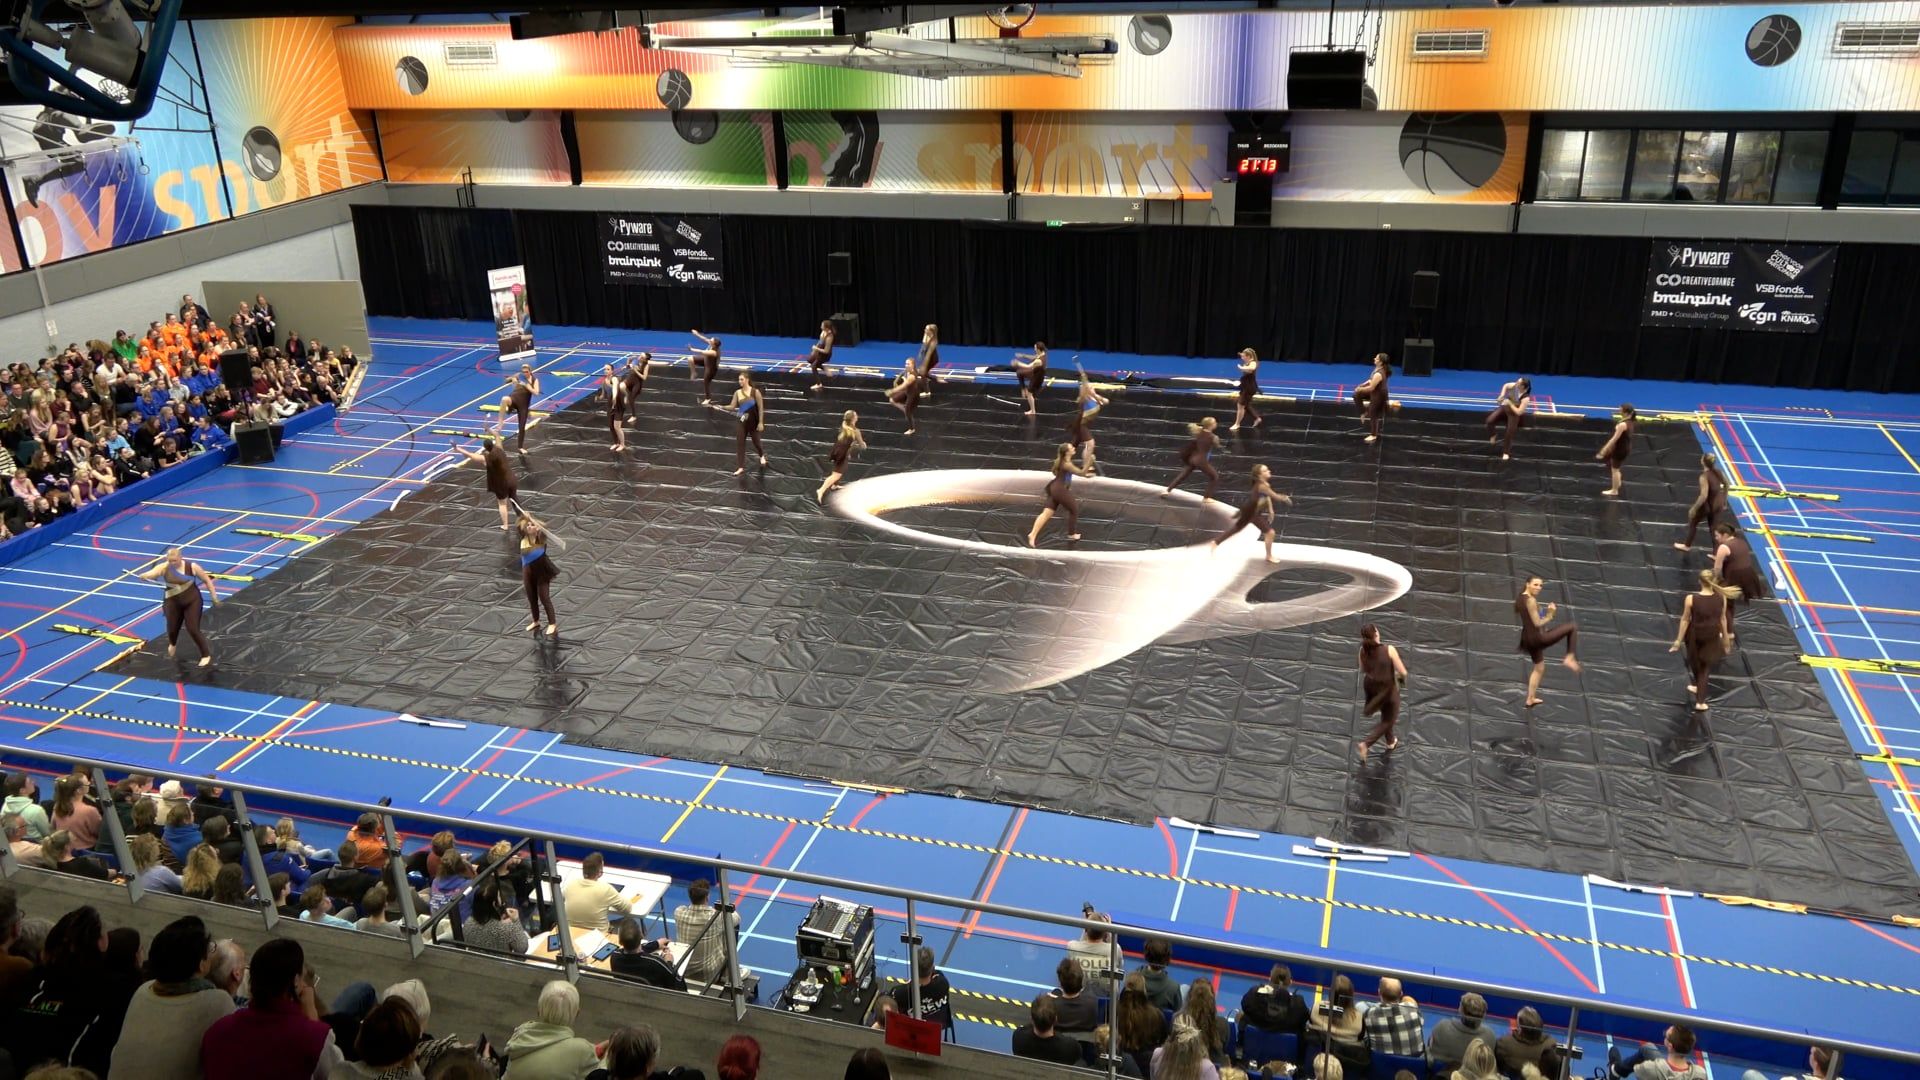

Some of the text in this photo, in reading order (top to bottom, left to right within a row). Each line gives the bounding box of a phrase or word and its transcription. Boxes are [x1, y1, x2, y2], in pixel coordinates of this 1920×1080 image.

[619, 219, 653, 236] Pyware
[608, 255, 662, 268] brainpink
[1681, 247, 1731, 267] Pyware
[675, 271, 695, 282] cgn
[1681, 276, 1736, 287] CREATIVEORANGE
[1652, 291, 1733, 307] brainpink
[1674, 311, 1709, 320] Consulting
[1709, 312, 1730, 321] Group
[1748, 311, 1777, 325] cgn
